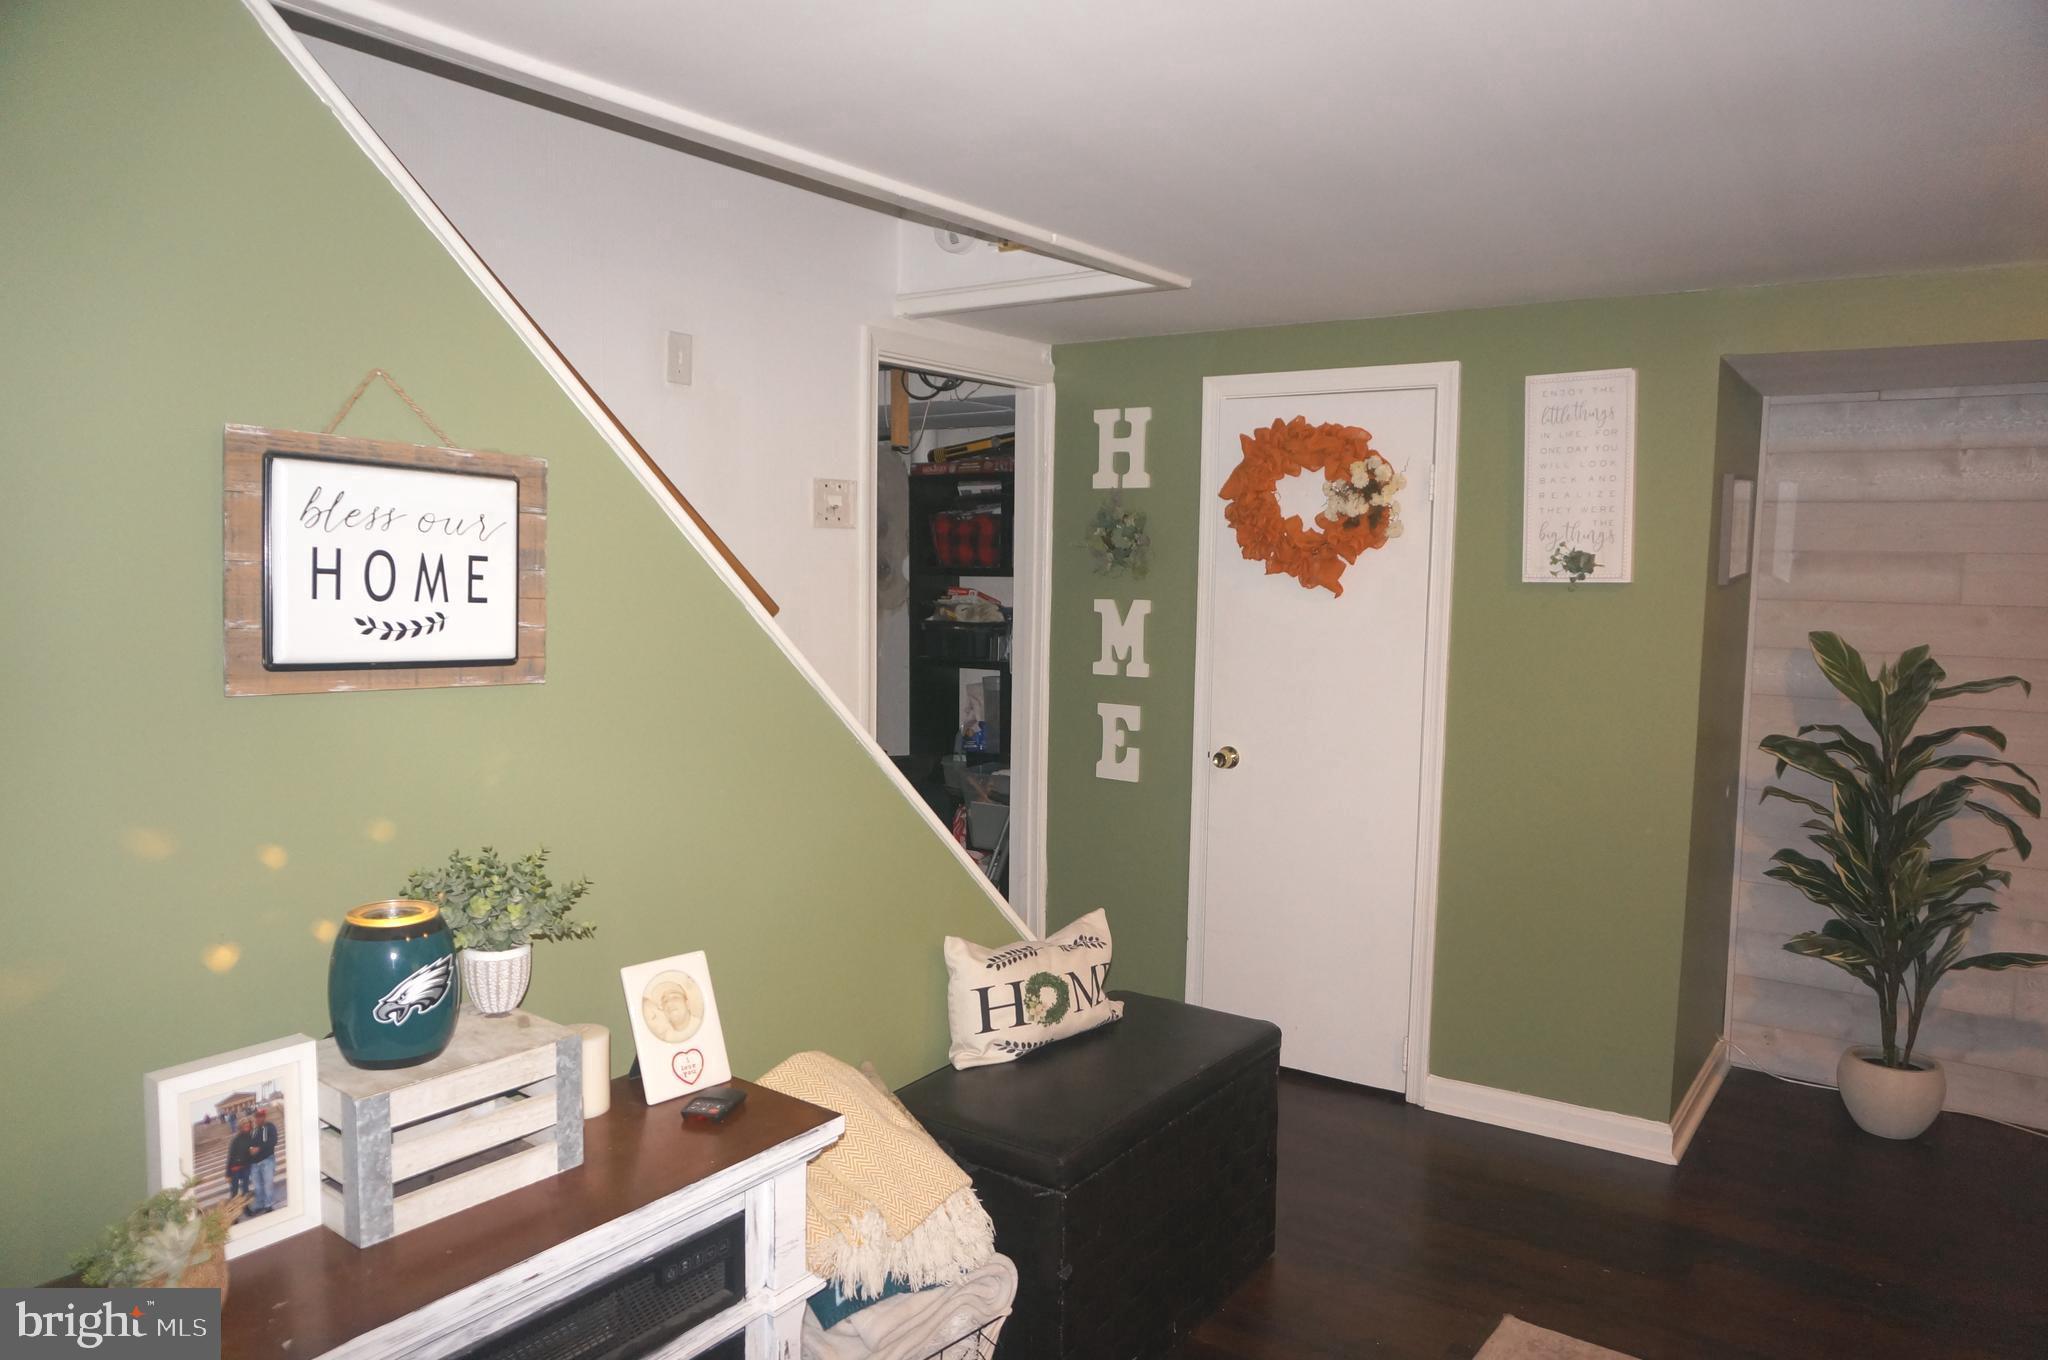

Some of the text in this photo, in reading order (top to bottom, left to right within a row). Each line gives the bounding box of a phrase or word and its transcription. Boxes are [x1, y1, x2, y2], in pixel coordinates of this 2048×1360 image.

[1542, 386, 1616, 398] ENJOY THE
[1541, 400, 1616, 428] little things
[1540, 432, 1550, 440] IN
[1595, 428, 1618, 437] FOR
[1540, 444, 1618, 455] ONE DAY YOU
[1540, 460, 1616, 470] WILL LOOK
[1539, 474, 1617, 485] BACK AND
[1539, 489, 1617, 499] REALIZE
[300, 486, 507, 542] bless our
[1539, 505, 1615, 514] THEY WERE
[1593, 519, 1615, 527] THE
[1539, 520, 1615, 552] big things
[311, 546, 489, 604] HOME
